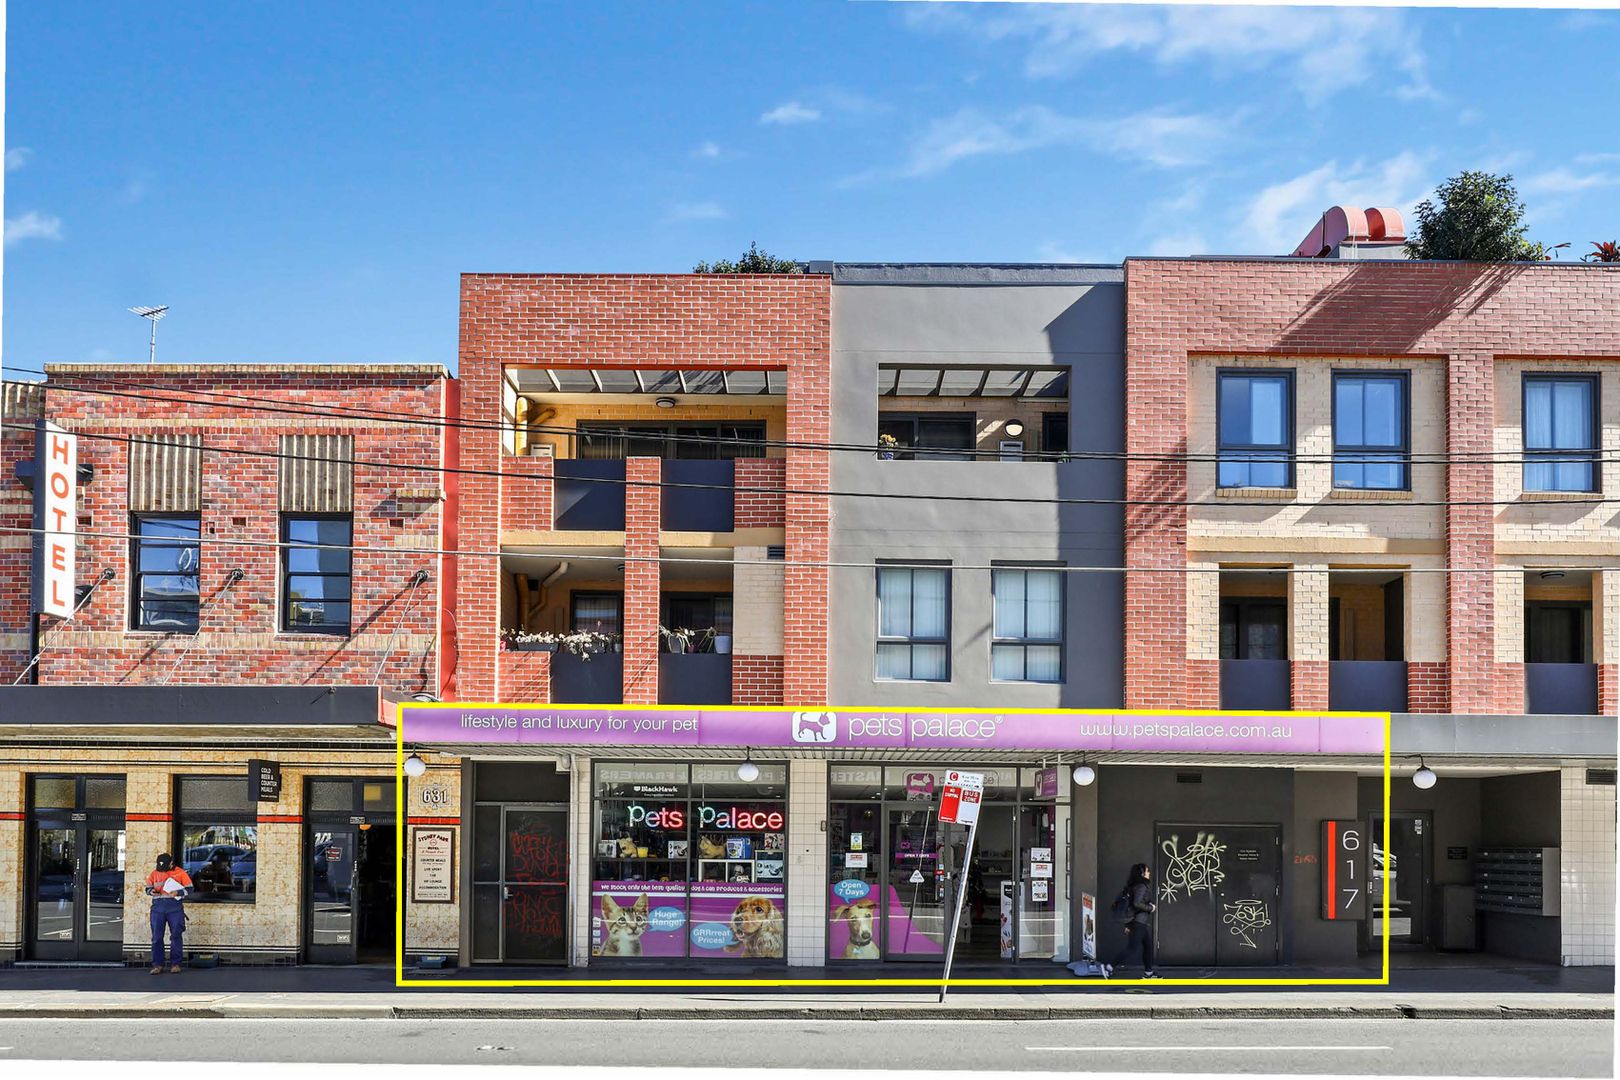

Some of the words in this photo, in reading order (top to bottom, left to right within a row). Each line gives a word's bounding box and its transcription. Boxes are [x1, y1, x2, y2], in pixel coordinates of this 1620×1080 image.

[51, 434, 69, 607] HOTEL
[461, 713, 517, 731] lifestyle
[522, 715, 551, 728] and
[557, 715, 602, 732] luxury
[608, 716, 628, 729] for
[633, 719, 666, 733] your
[672, 718, 697, 733] pet
[848, 714, 902, 741] pets
[1080, 722, 1292, 739] www.petspalace.com.au
[422, 788, 447, 804] 631
[1342, 830, 1360, 909] 617
[841, 881, 862, 890] Open
[845, 888, 864, 896] Days
[654, 910, 677, 919] Huge
[652, 919, 682, 928] Range!
[697, 936, 726, 944] Prices!
